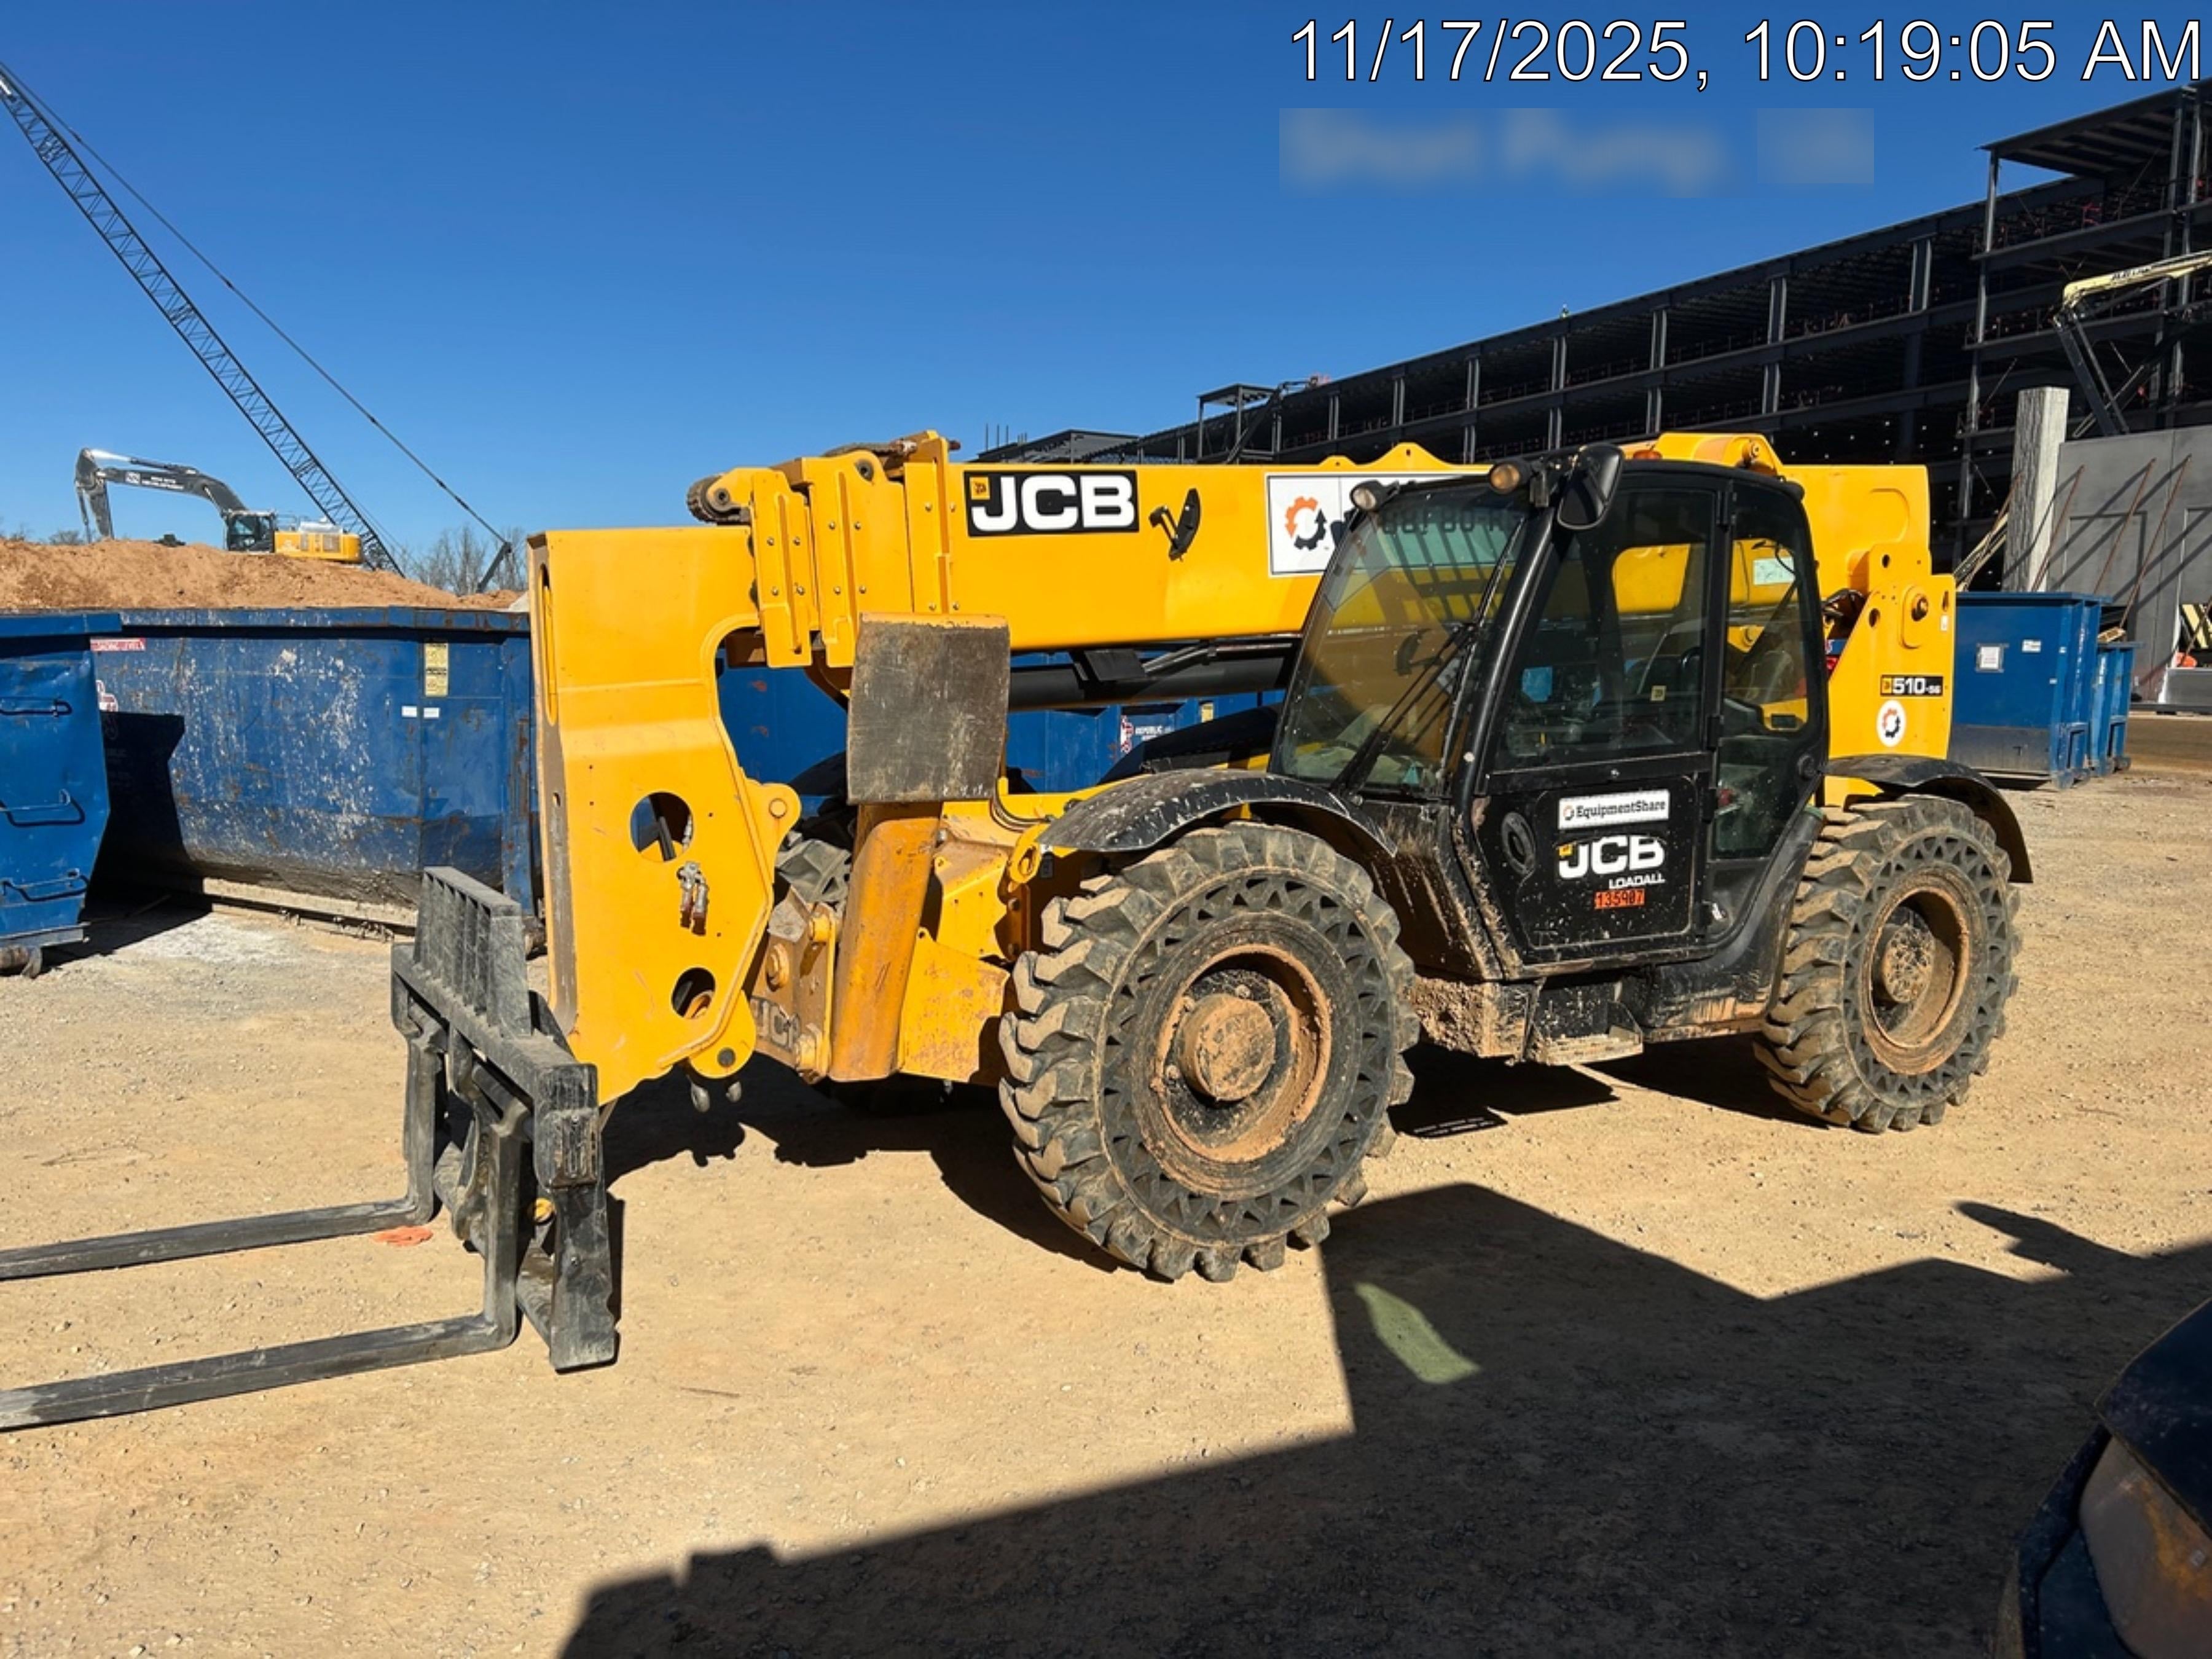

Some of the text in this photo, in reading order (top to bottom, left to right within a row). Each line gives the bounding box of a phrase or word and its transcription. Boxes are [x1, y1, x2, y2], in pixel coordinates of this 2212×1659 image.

[971, 475, 1135, 531] JCB
[1576, 800, 1666, 819] EquipmentShare
[1558, 836, 1665, 879] JCB
[1608, 873, 1666, 890] LOADALL
[1598, 889, 1644, 906] 135907
